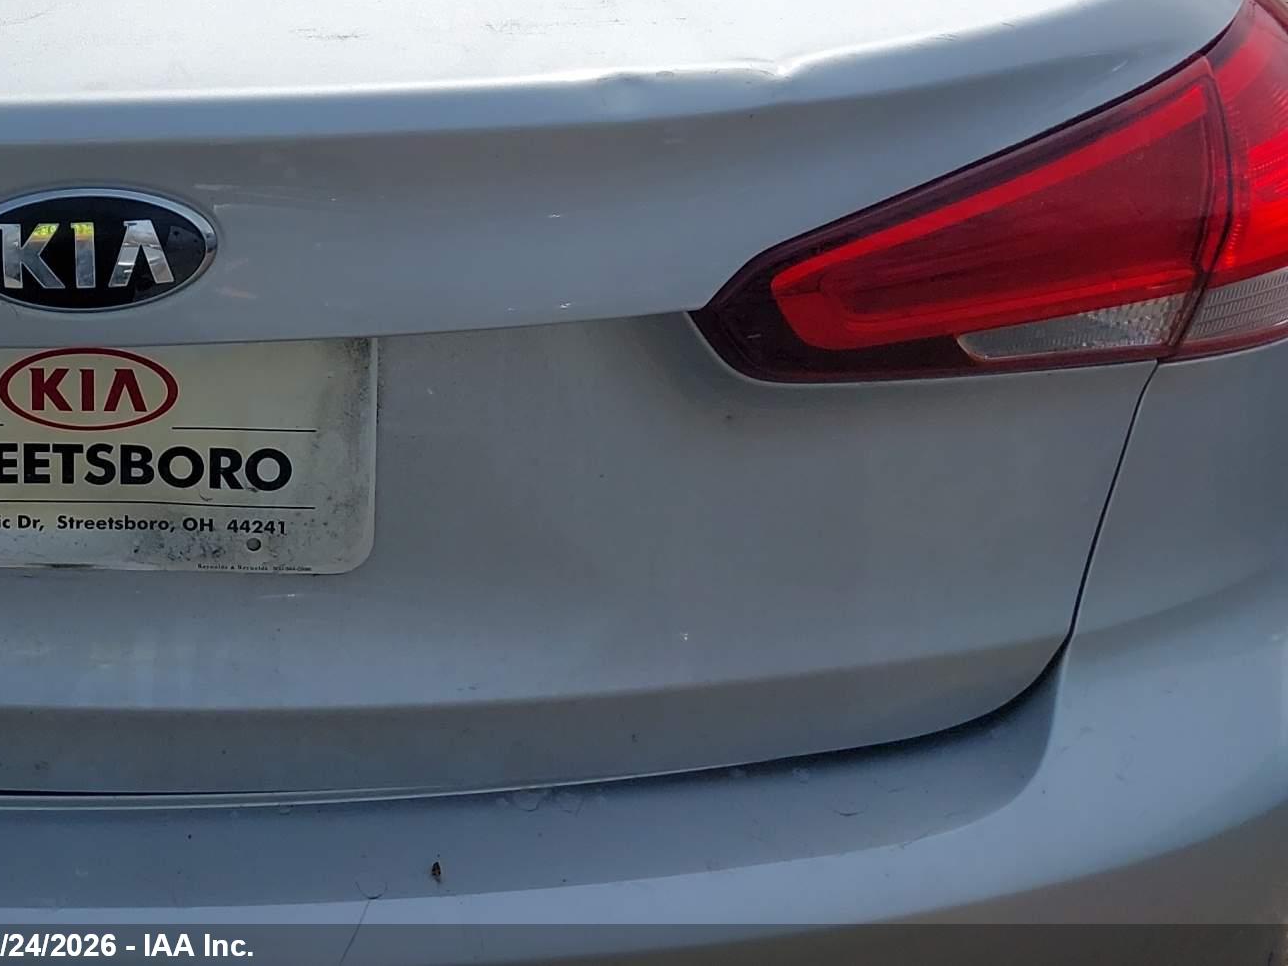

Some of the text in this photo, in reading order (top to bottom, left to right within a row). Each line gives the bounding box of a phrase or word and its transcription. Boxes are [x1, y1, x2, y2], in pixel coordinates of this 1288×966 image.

[29, 367, 149, 413] KIA
[17, 514, 45, 531] Dr,
[57, 514, 175, 533] Streetsboro,
[182, 517, 214, 532] OH
[226, 519, 287, 535] 44241
